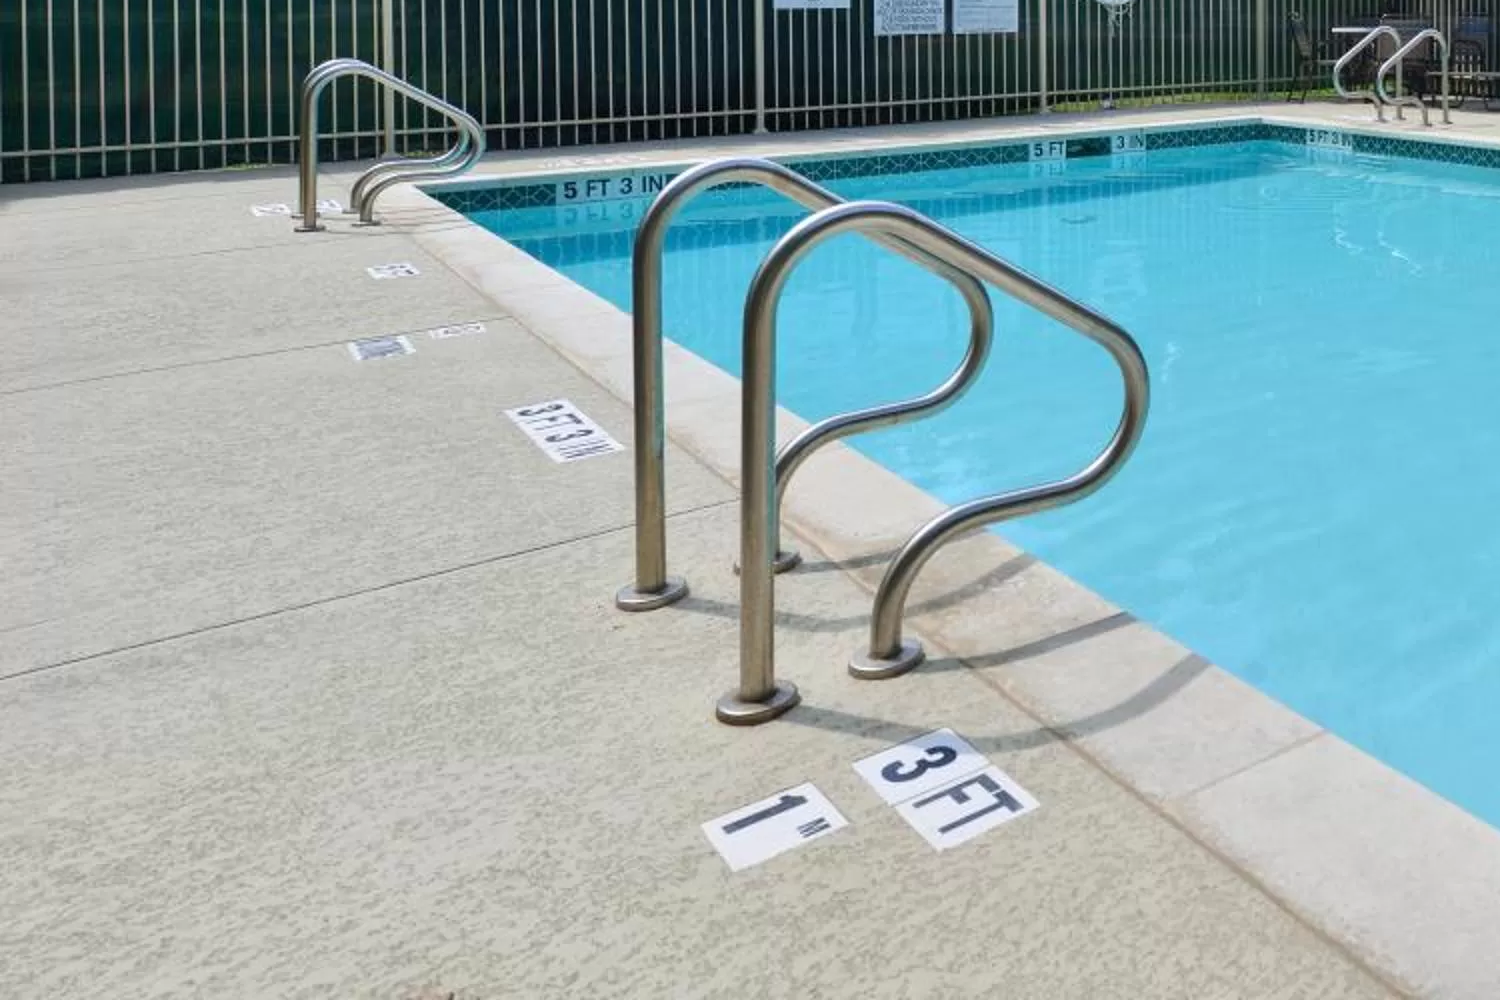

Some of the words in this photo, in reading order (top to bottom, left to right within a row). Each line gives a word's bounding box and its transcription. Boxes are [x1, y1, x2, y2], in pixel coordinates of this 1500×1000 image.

[1034, 143, 1044, 157] 5
[1049, 141, 1064, 156] FT
[1116, 136, 1125, 150] 3
[563, 181, 578, 199] 5
[586, 178, 611, 198] FT
[620, 177, 633, 195] 3
[642, 175, 663, 193] IN
[525, 413, 585, 431] FT
[881, 744, 958, 783] 3
[911, 773, 1026, 835] FT
